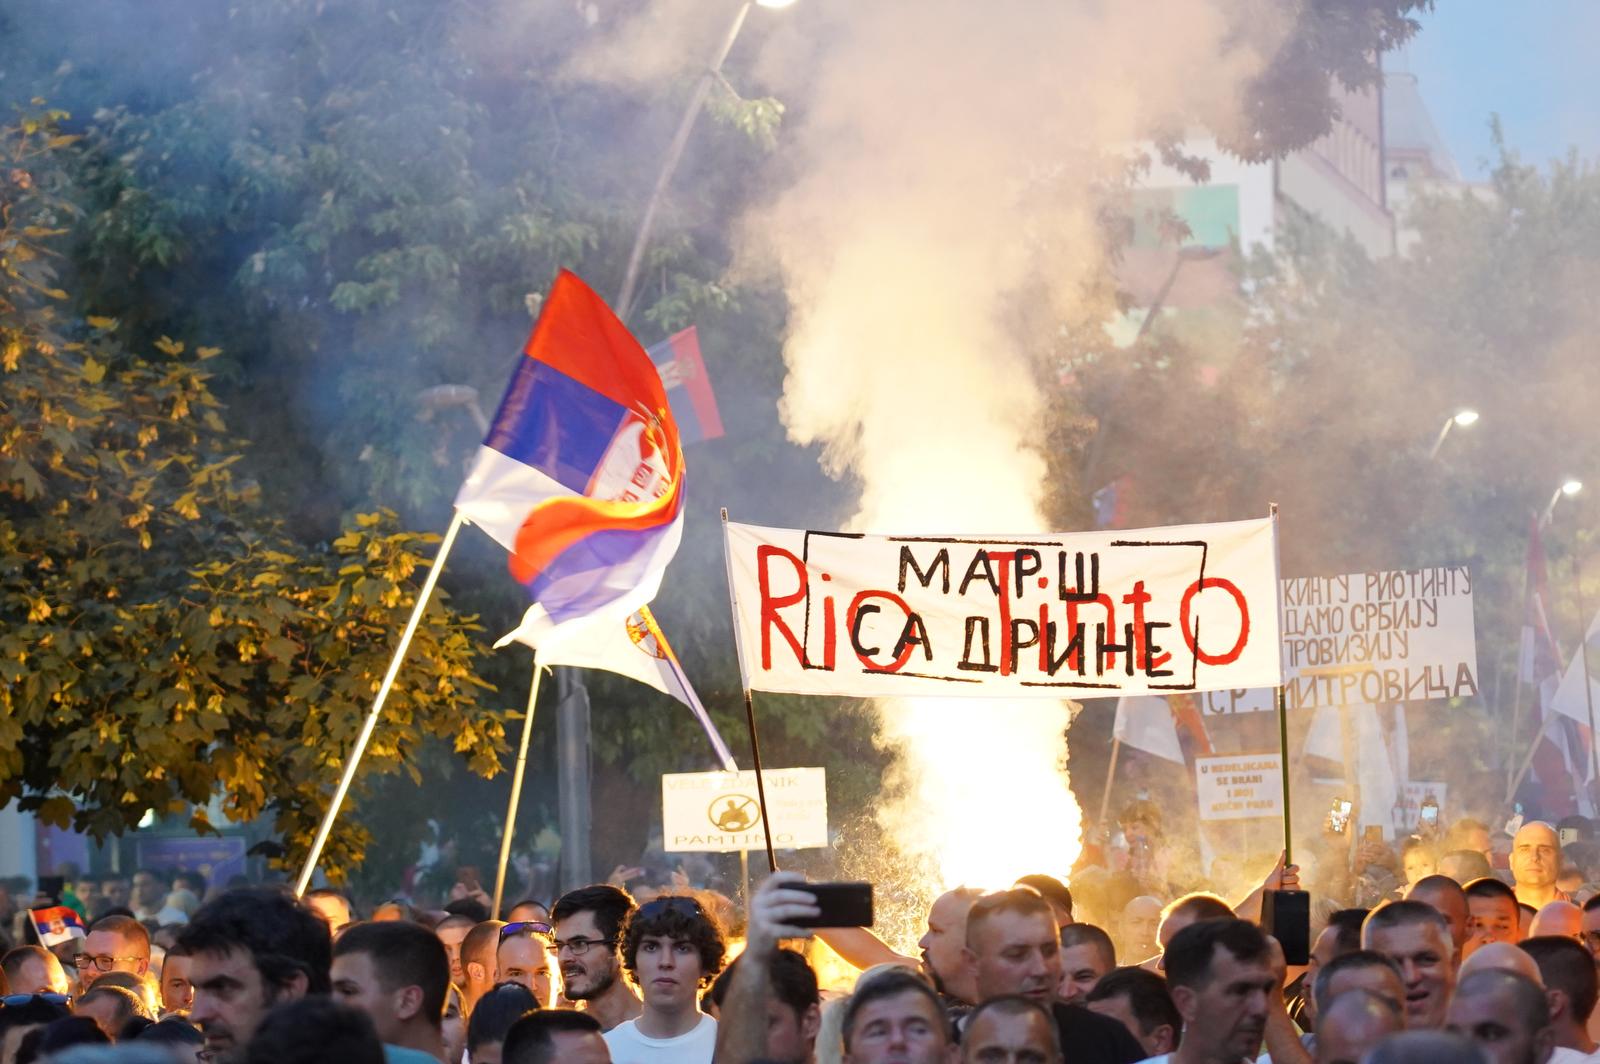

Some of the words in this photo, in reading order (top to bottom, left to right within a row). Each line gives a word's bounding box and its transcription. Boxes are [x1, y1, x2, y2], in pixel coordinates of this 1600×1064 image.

[898, 545, 1099, 601] МАРШ
[851, 604, 933, 662] СА
[957, 615, 1176, 678] ДРИНЕ
[1350, 598, 1438, 633] СРБИЈУ
